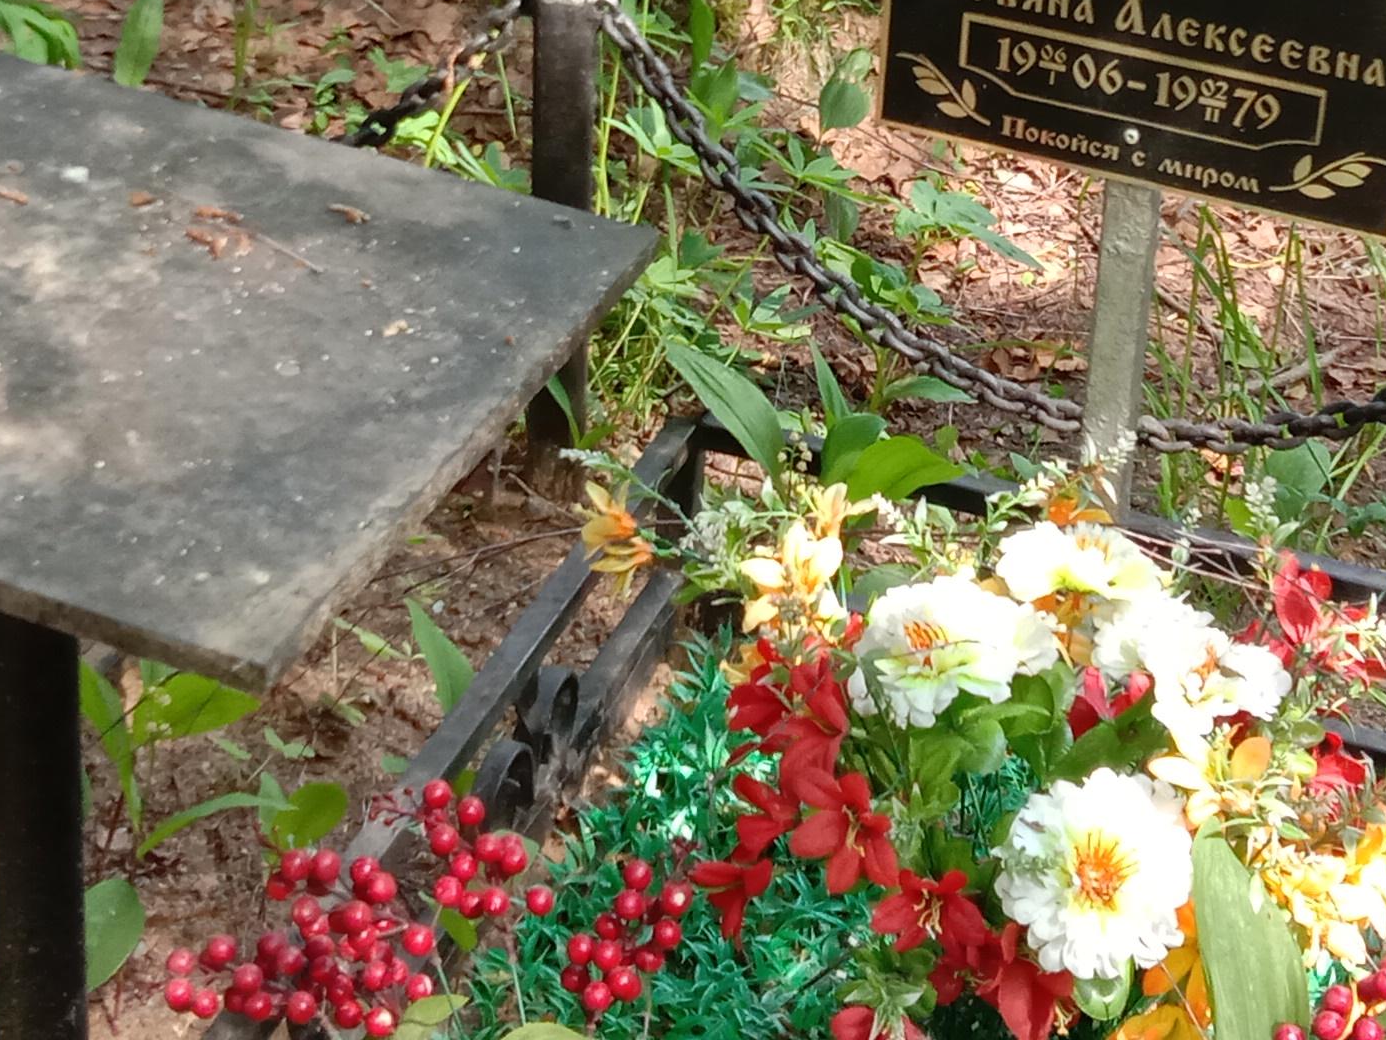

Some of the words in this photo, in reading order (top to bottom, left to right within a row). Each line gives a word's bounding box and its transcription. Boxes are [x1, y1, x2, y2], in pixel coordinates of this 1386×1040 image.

[1001, 115, 1120, 162] Покойся
[1132, 150, 1146, 167] с
[1158, 157, 1260, 194] миром
